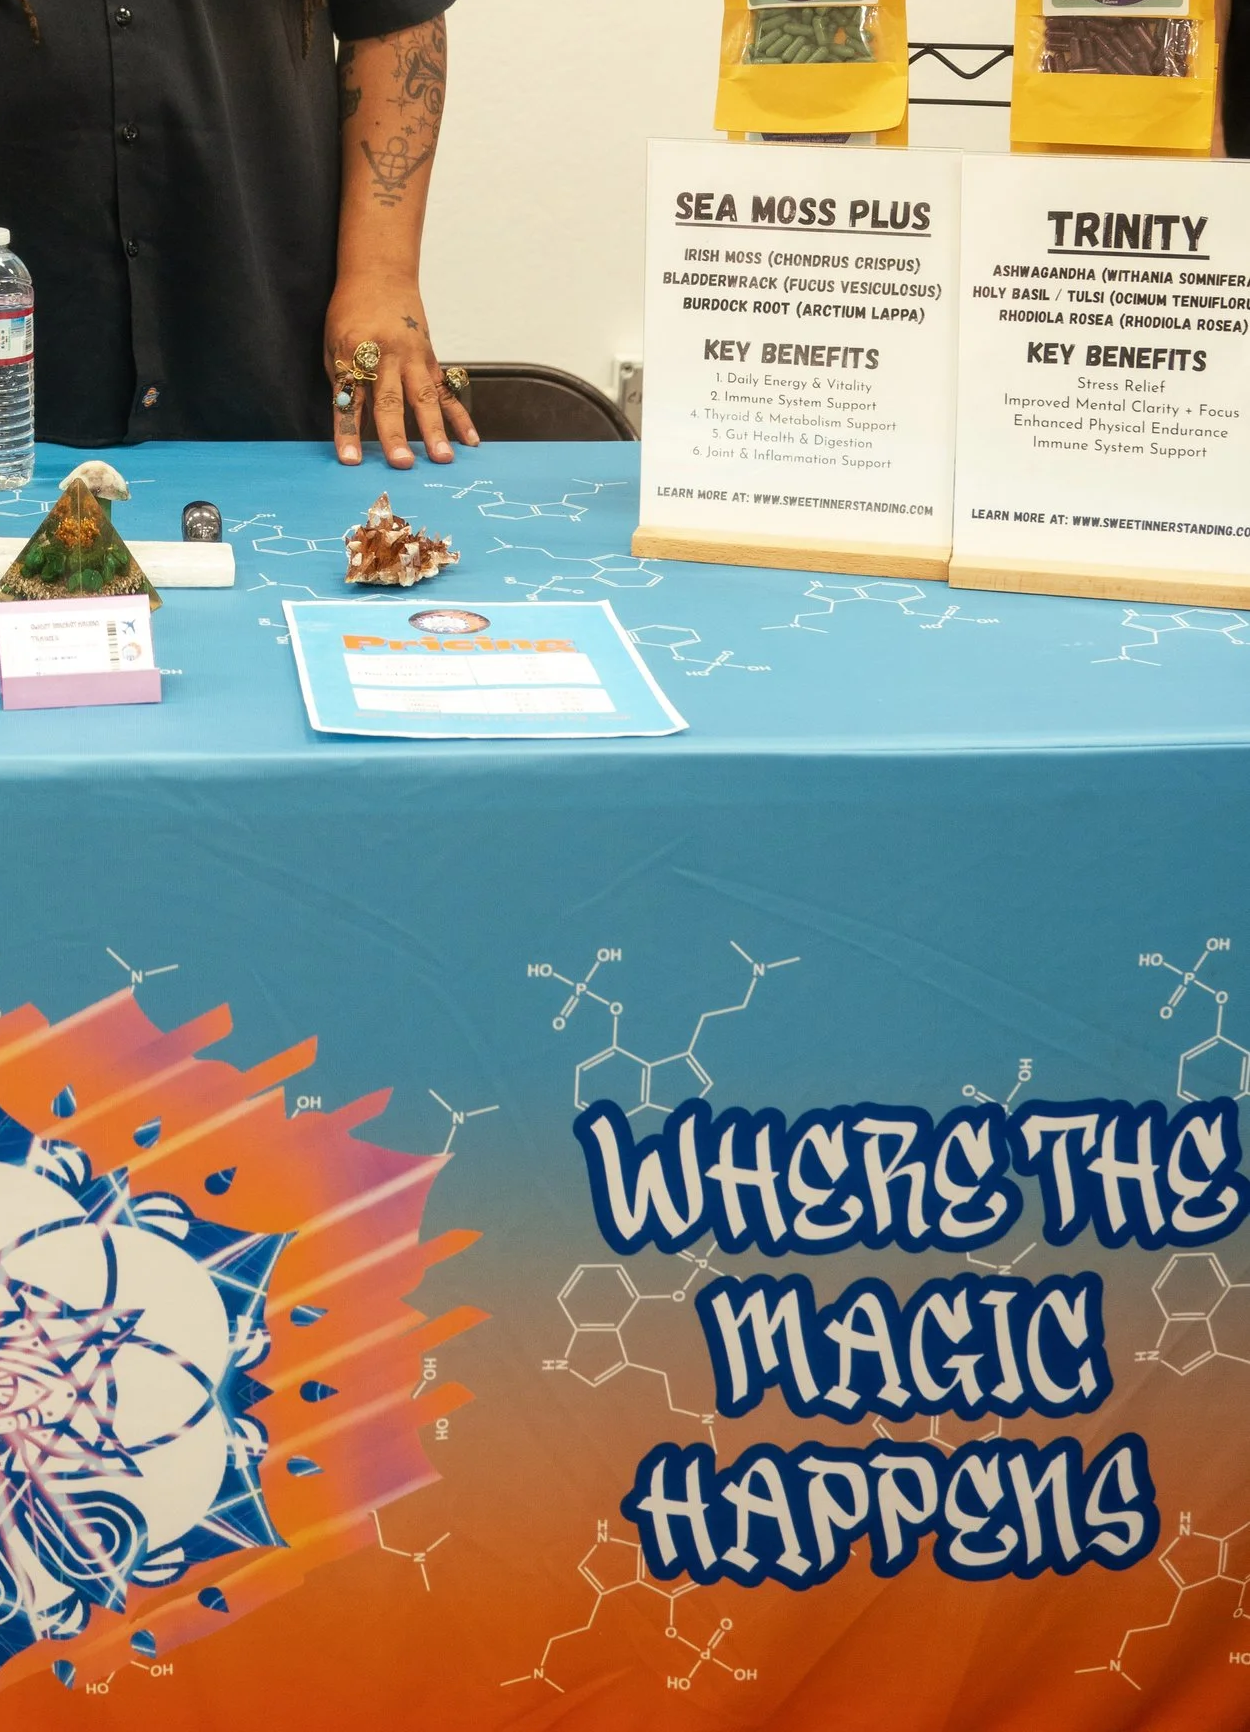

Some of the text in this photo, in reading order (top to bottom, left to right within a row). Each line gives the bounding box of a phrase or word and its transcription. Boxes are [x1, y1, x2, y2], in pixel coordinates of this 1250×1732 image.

[674, 191, 931, 231] SEA MOSS PLUS
[1047, 210, 1209, 252] TRINITY
[684, 248, 921, 275] IRISH MOSS (CHONDRUS CRISPUS)
[662, 271, 942, 301] BLADDERWRACK (FUCUS VESICULOSUS)
[992, 264, 1096, 281] ASHWAGANDHA
[1101, 267, 1174, 285] (WITHANIA
[972, 285, 1007, 299] HOLY
[1011, 287, 1050, 301] BASIL
[1067, 290, 1105, 304] TULSI
[1109, 290, 1167, 307] (OCIMUM
[682, 297, 925, 325] BURDOCK ROOT (ARCTIUM LAPPA)
[999, 309, 1249, 336] RHODIOLA ROSEA (RHODIOLA ROSEA)
[703, 338, 880, 370] KEY BENEFITS
[1027, 341, 1207, 372] KEY BENEFITS
[716, 372, 872, 394] 1. Daily Energy & Vitality
[1077, 376, 1166, 393] Stress Relief
[710, 390, 877, 412] 2. Immune System Support
[1004, 392, 1240, 419] Improved Mental Clarity + Focus
[690, 407, 897, 433] 4. Thyroid & Metabolism Support
[1014, 413, 1228, 439] Enhanced Physical Endurance
[712, 428, 873, 449] 5. Gut Health & Digestion
[1033, 435, 1207, 459] Immune System Support
[692, 445, 892, 470] 6. Joint & Inflammation Support
[657, 486, 933, 516] LEARN MORE AT: WWW.SWEETINNERSTANDING.COM
[971, 508, 1010, 521] LEARN
[1013, 511, 1046, 524] MORE
[1049, 514, 1069, 525] AT:
[341, 634, 578, 654] Pricing
[597, 948, 622, 962] OH
[1206, 938, 1231, 951] OH
[527, 963, 552, 978] HO
[1138, 953, 1163, 967] HO
[296, 1096, 323, 1110] OH
[710, 1284, 1099, 1411] MAGIC
[636, 1445, 1146, 1578] HAPPENS
